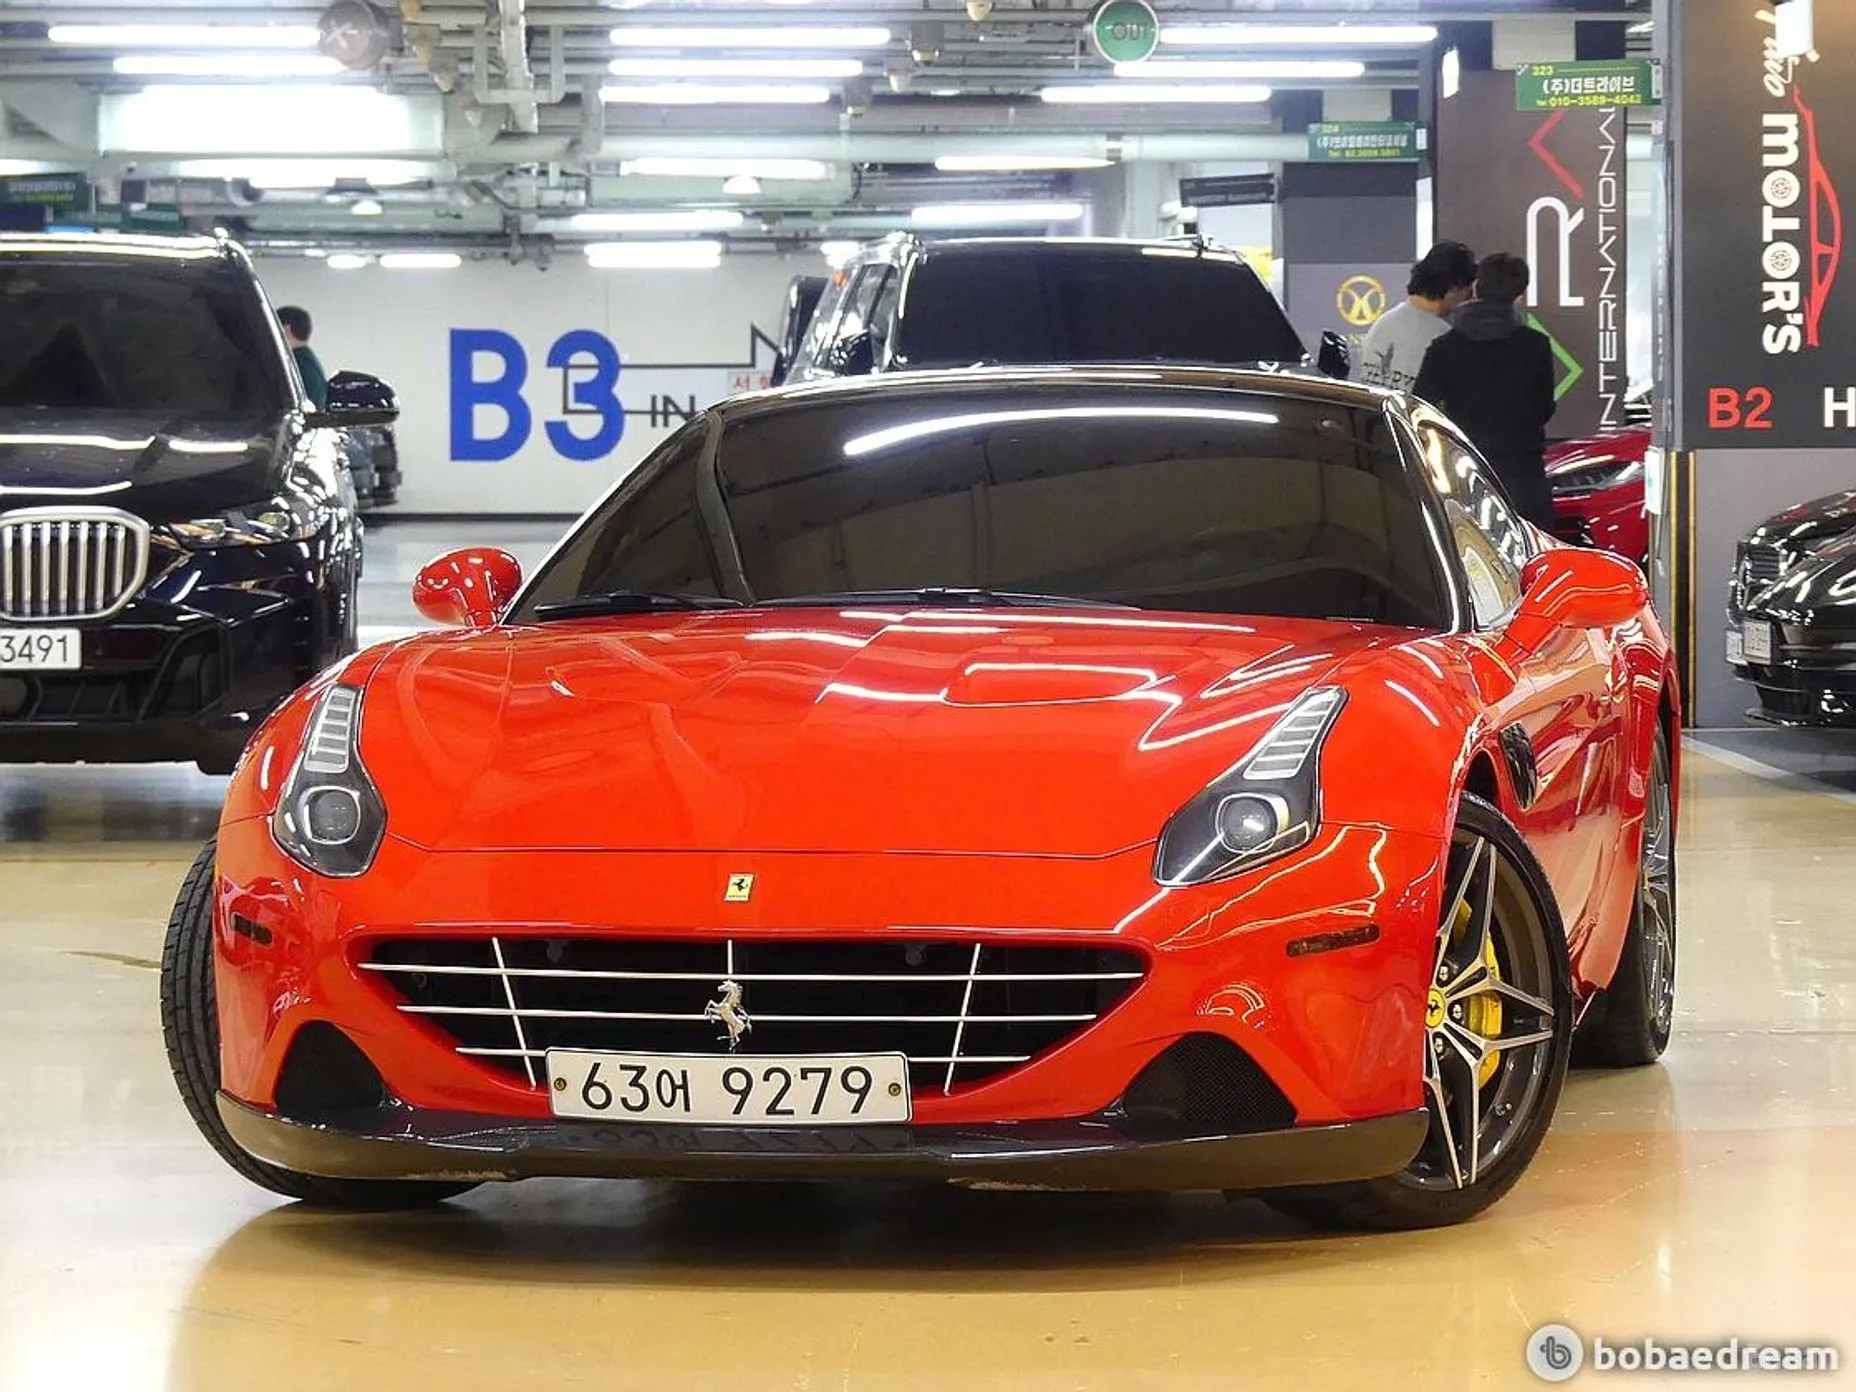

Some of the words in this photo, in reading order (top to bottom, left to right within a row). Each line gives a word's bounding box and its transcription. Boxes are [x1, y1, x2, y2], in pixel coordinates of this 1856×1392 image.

[449, 328, 625, 461] B3
[650, 394, 696, 427] IN
[1708, 387, 1774, 428] B2
[1823, 386, 1856, 428] H
[0, 634, 68, 663] 3491
[581, 1061, 692, 1113] 63어
[721, 1065, 873, 1116] 9279
